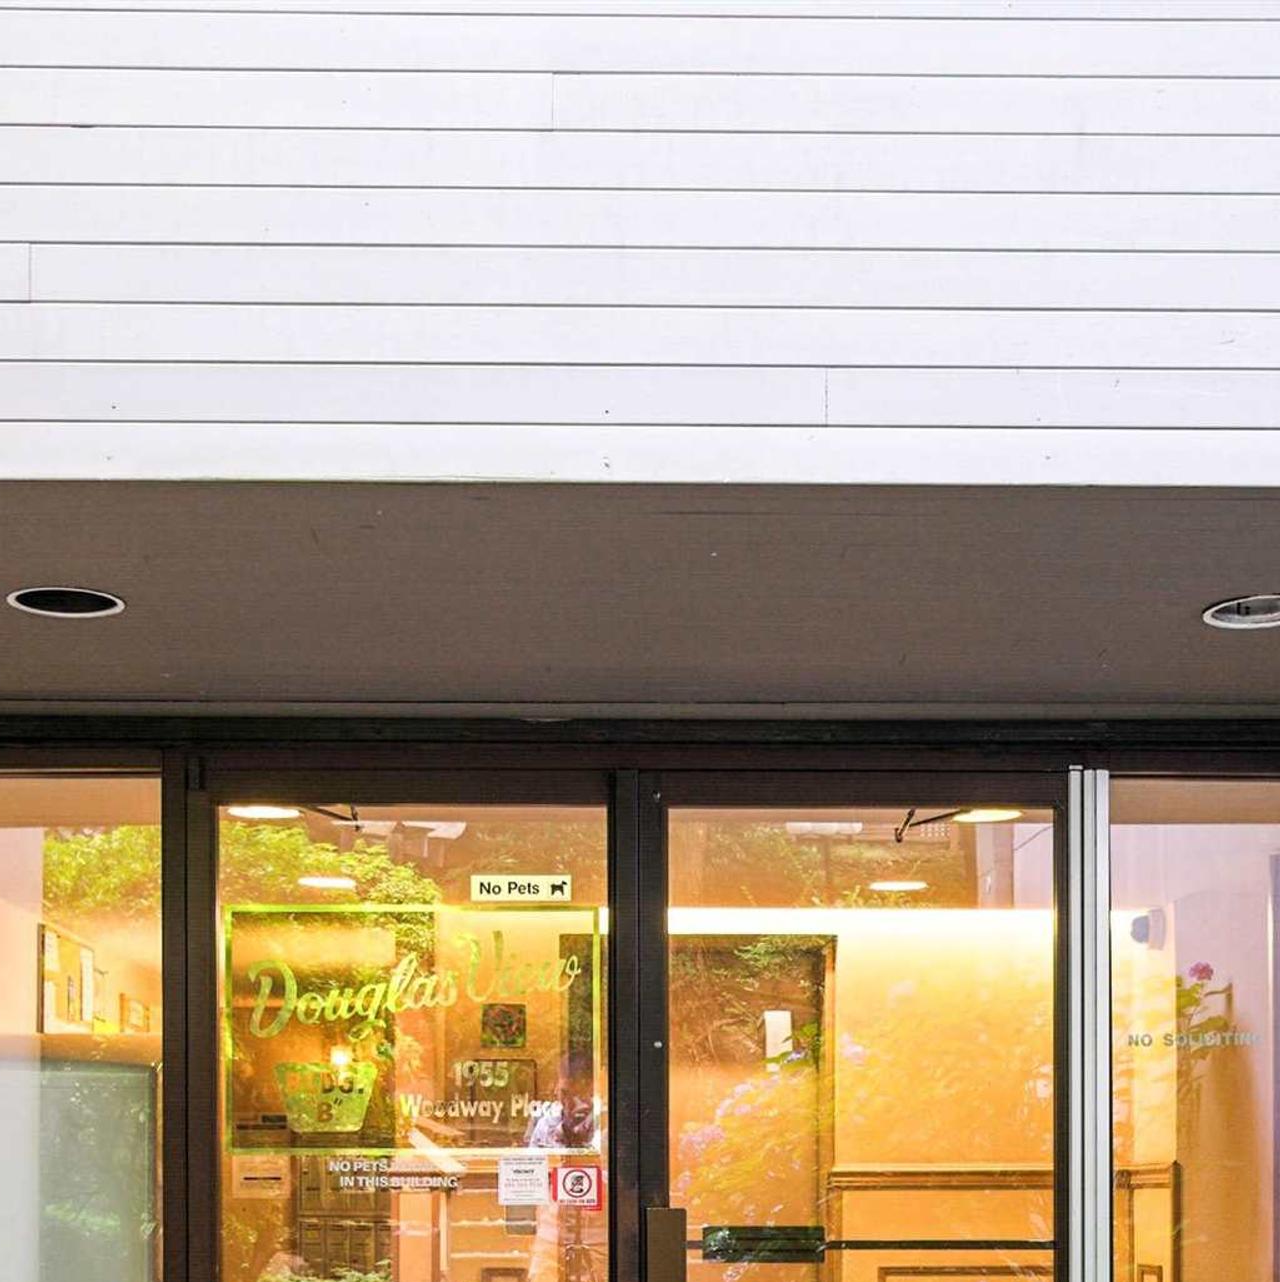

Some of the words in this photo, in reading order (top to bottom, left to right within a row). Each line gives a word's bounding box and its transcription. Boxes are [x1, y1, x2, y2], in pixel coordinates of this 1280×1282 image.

[480, 881, 502, 895] No
[507, 881, 540, 895] Pets
[248, 951, 459, 1042] Douglas
[455, 930, 582, 1003] View
[1127, 1033, 1153, 1047] NO
[452, 1060, 510, 1088] 1955
[399, 1093, 505, 1125] Woodway
[510, 1092, 564, 1119] Place
[329, 1160, 351, 1172] NO
[353, 1160, 388, 1172] PETS
[339, 1175, 355, 1188] IN
[356, 1175, 389, 1188] THIS
[390, 1175, 459, 1188] BUILDING
